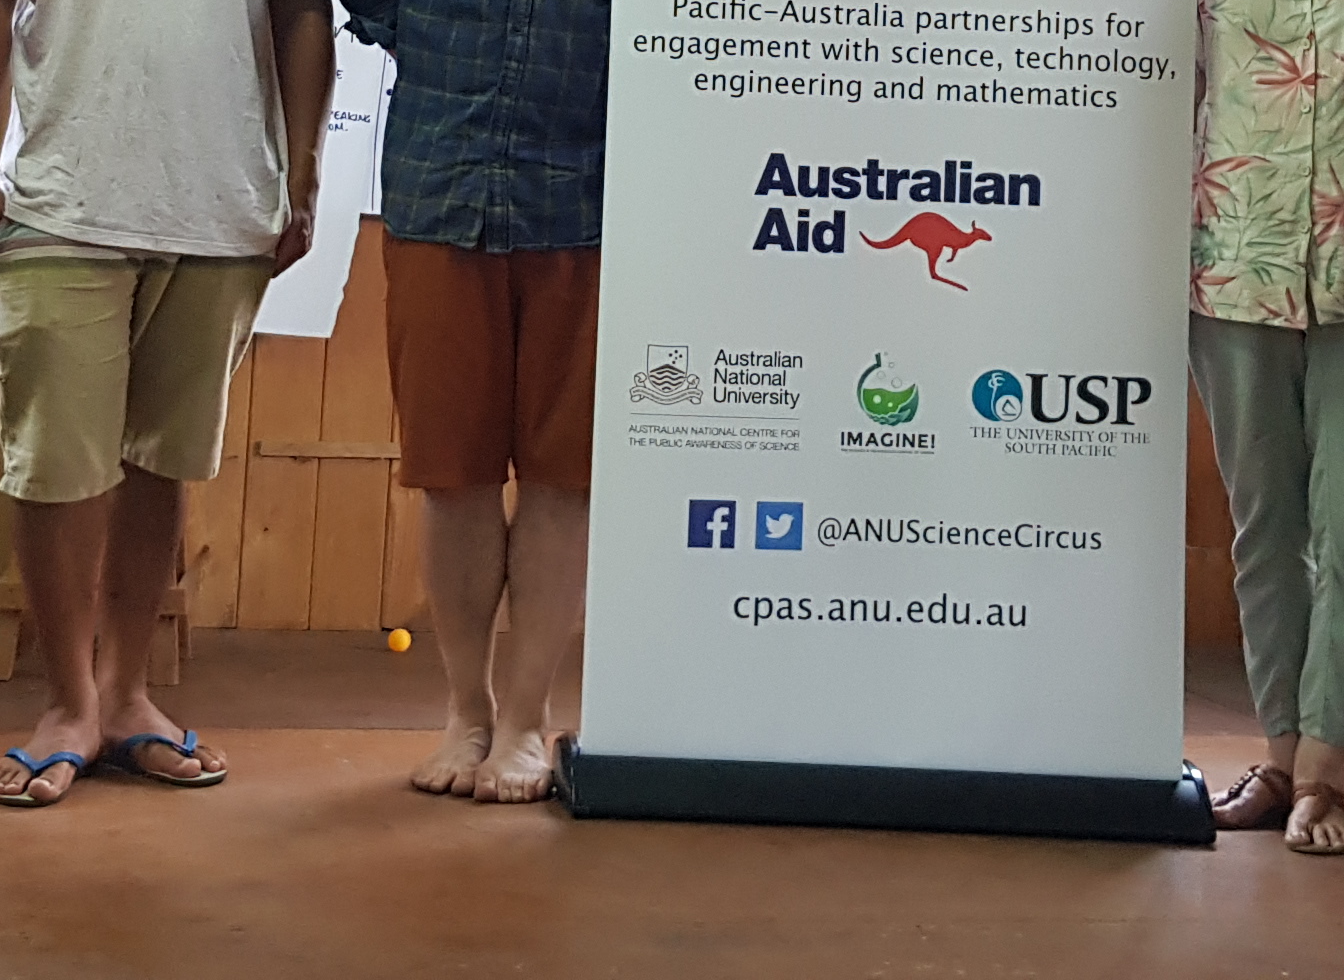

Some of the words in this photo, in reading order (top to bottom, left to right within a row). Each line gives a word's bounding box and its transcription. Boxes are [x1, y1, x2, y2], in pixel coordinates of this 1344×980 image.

[916, 9, 1094, 39] partnerships
[1106, 12, 1145, 38] for
[633, 33, 812, 61] engagement
[821, 37, 879, 63] with
[891, 41, 1004, 71] science,
[1015, 45, 1176, 80] technology,
[694, 69, 863, 103] engineering
[873, 75, 925, 100] and
[936, 78, 1118, 108] mathematics
[331, 110, 371, 123] EAKING
[754, 152, 1042, 207] Australian
[752, 207, 846, 254] Aid
[713, 348, 804, 369] Australian
[713, 367, 787, 387] National
[713, 386, 801, 410] University
[1025, 373, 1152, 426] USP
[628, 424, 688, 435] AUSTRALIAN
[690, 426, 738, 437] NATIONAL
[739, 427, 778, 438] CENTRE
[780, 428, 800, 438] FOR
[840, 431, 936, 449] IMAGINE!
[969, 425, 1002, 439] THE
[1006, 427, 1095, 443] UNIVERSITY
[1097, 431, 1118, 444] OF
[1120, 431, 1151, 444] THE
[628, 437, 647, 447] THE
[648, 437, 683, 448] PUBLIC
[685, 439, 743, 450] AWARENESS
[744, 440, 757, 450] OF
[758, 441, 800, 452] SCIENCE
[1005, 441, 1057, 455] SOUTH
[1060, 443, 1119, 457] PACIFIC
[816, 517, 1103, 551] @ANUScienceCircus
[733, 592, 1028, 628] cpas.anu.edu.au
